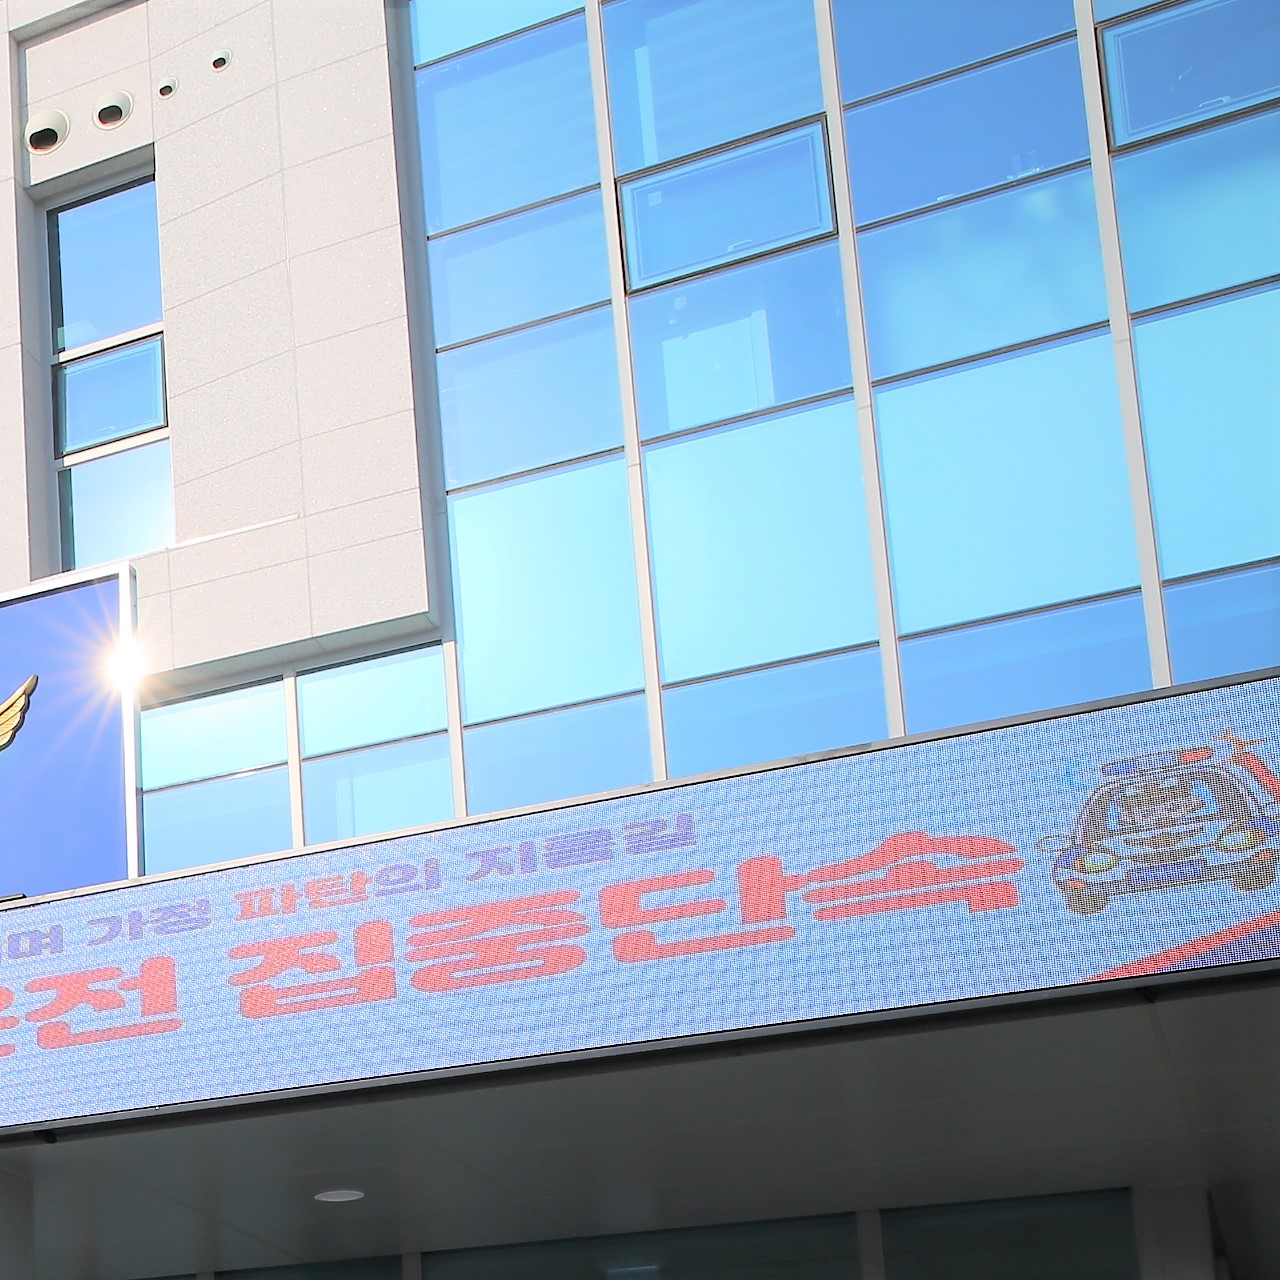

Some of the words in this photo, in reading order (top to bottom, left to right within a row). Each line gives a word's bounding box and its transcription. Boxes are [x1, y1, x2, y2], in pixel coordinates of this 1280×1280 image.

[88, 898, 213, 946] 가정
[233, 856, 440, 922] 파탄의
[464, 813, 697, 878] 지름길
[229, 830, 1023, 1018] 집중단속
